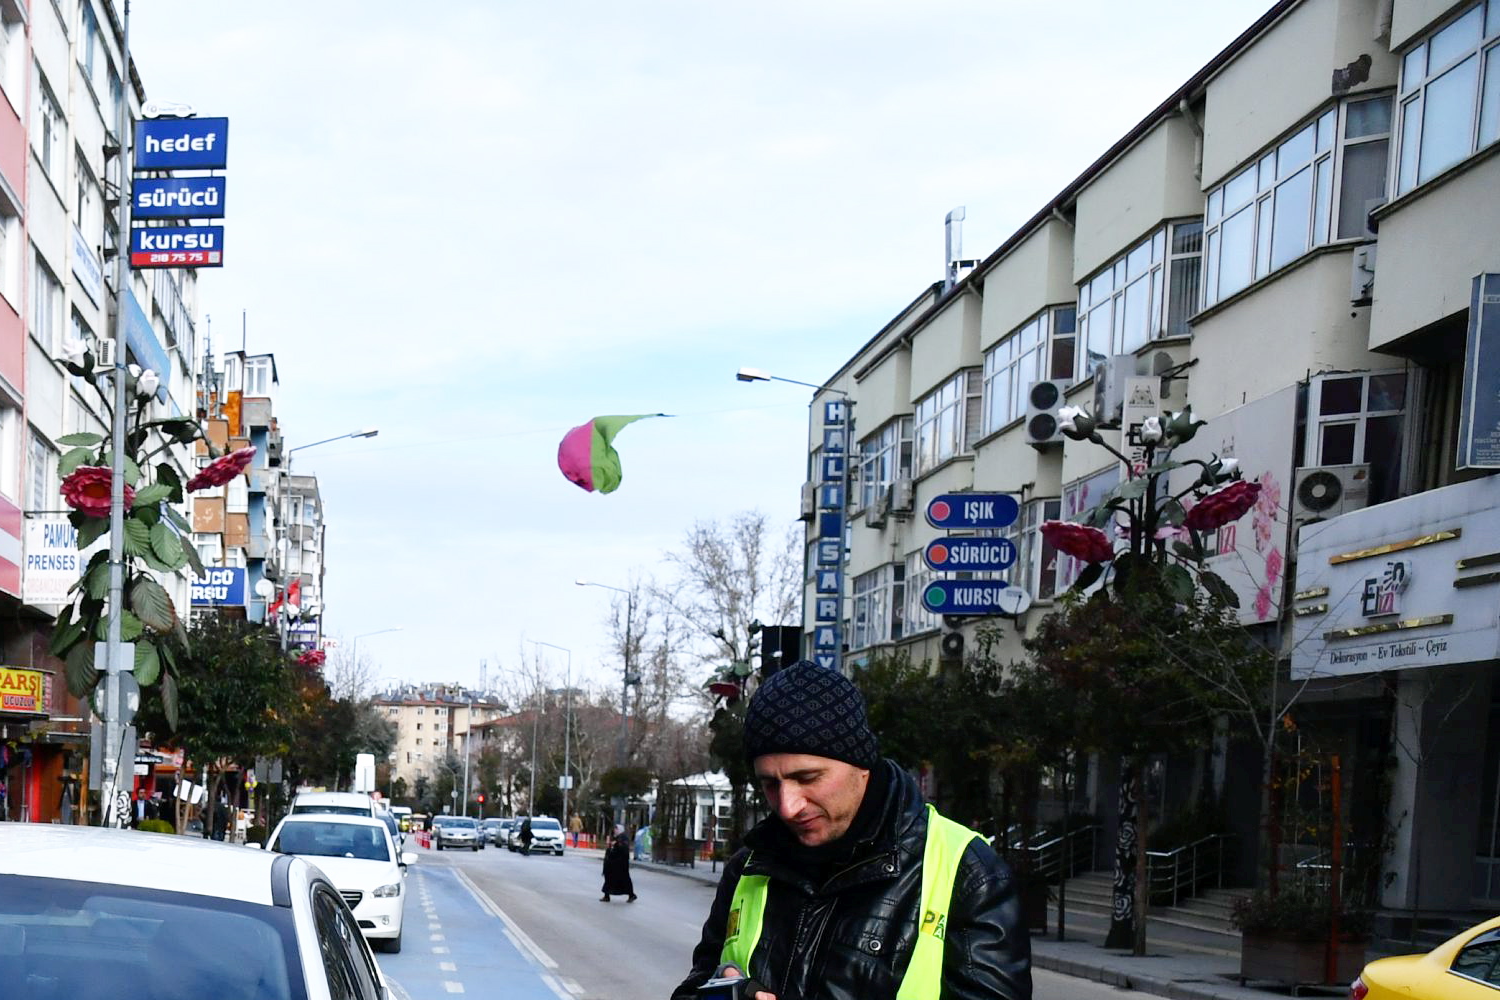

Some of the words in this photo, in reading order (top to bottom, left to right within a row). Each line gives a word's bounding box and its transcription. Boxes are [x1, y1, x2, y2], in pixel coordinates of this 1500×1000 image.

[145, 133, 216, 153] hedef
[138, 187, 218, 208] sürücü
[140, 231, 214, 249] kursu
[150, 254, 169, 263] 218
[172, 253, 186, 262] 75
[190, 253, 203, 261] 75
[964, 502, 995, 524] IŞIK
[44, 523, 77, 548] PAMUK
[27, 555, 75, 571] PRENSES
[950, 542, 1010, 564] SÜRÜCÜ
[1330, 651, 1368, 666] Dekorasyon
[1378, 647, 1387, 660] Ev
[1389, 642, 1417, 657] Tekstili
[1426, 640, 1447, 656] Çeyiz
[3, 695, 36, 707] UCUZLUK
